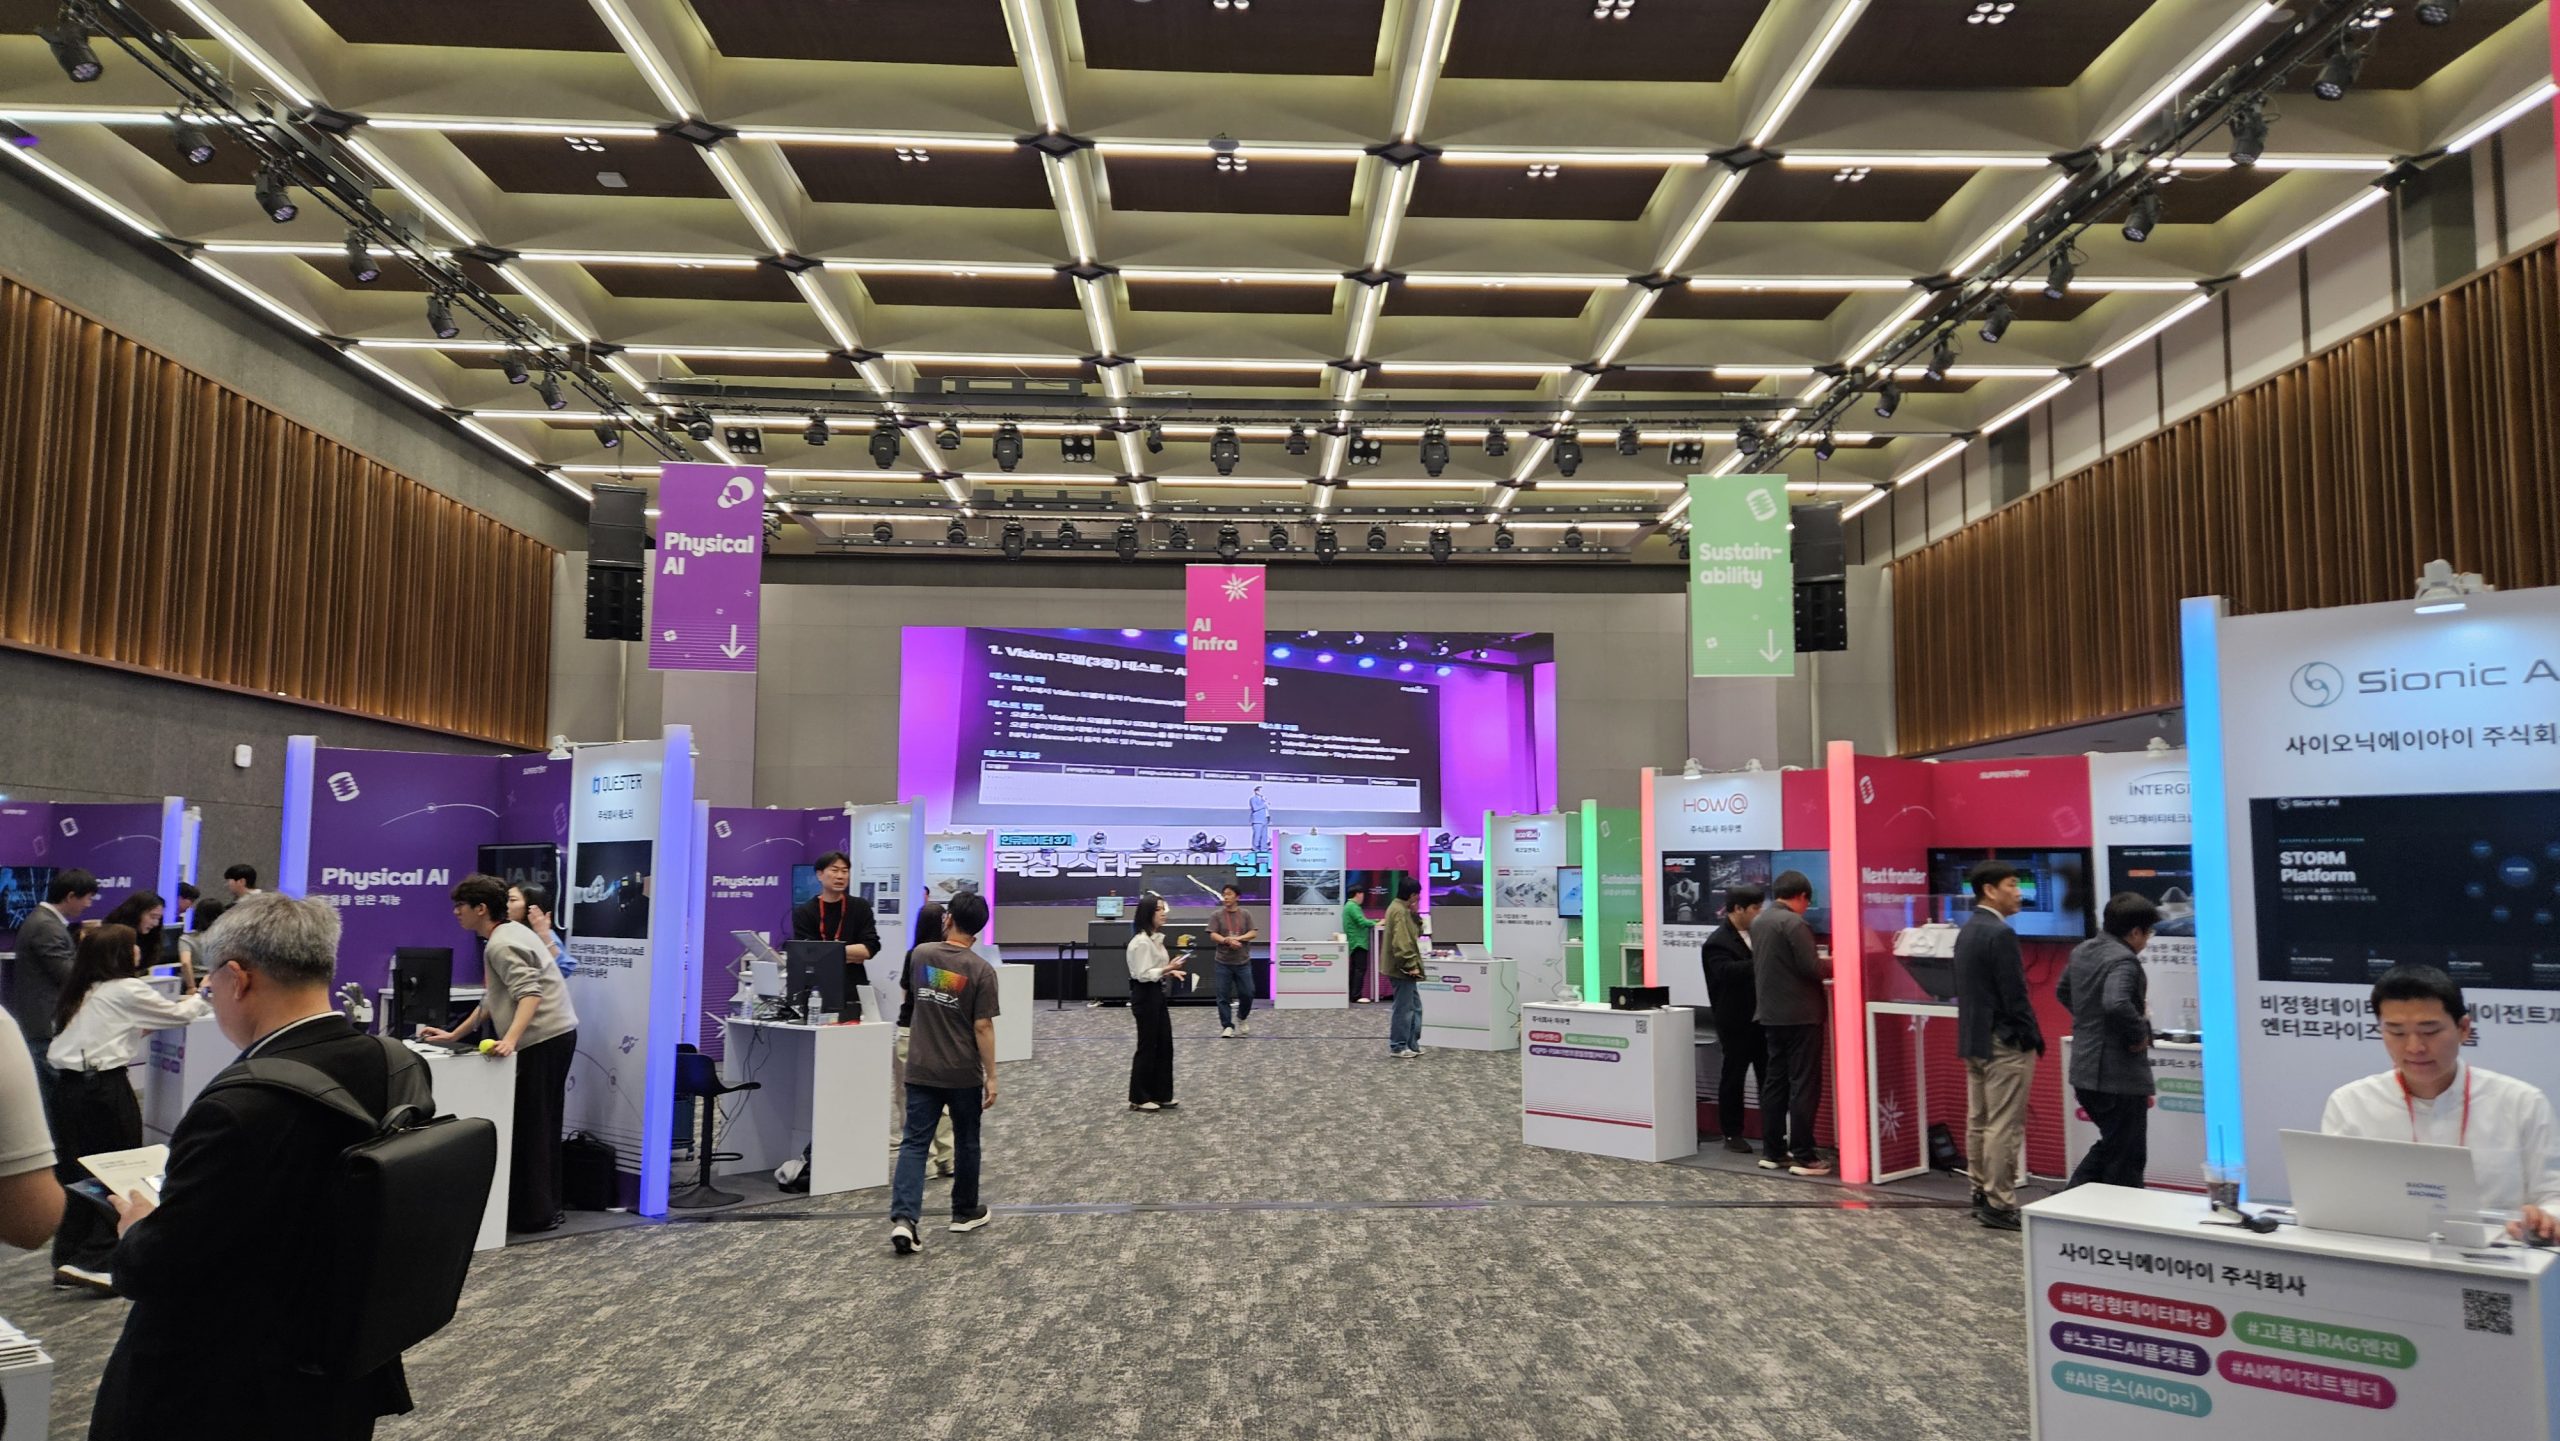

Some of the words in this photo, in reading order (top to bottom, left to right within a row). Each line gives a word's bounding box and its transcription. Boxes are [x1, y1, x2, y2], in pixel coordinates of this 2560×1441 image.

[664, 531, 755, 557] Physical
[1699, 542, 1783, 560] Sustain-
[662, 557, 685, 575] AI
[1700, 566, 1763, 589] ability
[1193, 618, 1211, 632] AI
[1193, 636, 1238, 651] Infra
[1005, 646, 1054, 662] Vision
[1055, 651, 1121, 671] 모델(3종)
[1122, 660, 1164, 674] 테스트
[2358, 662, 2507, 694] Sionic
[2285, 727, 2474, 756] 사이오닉에이아이
[2482, 722, 2560, 748] 주식회
[1683, 793, 1748, 814] HOW@
[2291, 798, 2325, 808] Sionic
[1000, 834, 1052, 846] 인큐베이터
[997, 852, 1060, 877] 육성
[2280, 851, 2346, 865] STORM
[321, 867, 423, 891] Physical
[426, 868, 449, 886] AI
[712, 875, 765, 889] Physical
[2281, 868, 2357, 882] Platform
[379, 895, 401, 906] 지능
[2058, 1241, 2214, 1283] 사이오닉에이아이
[2221, 1266, 2306, 1297] 주식회사
[2061, 1289, 2212, 1331] #비정형데이터파싱
[2063, 1329, 2197, 1369] #노코드AI플랫폼
[2247, 1319, 2401, 1361] #고품질RAG엔진
[2064, 1369, 2198, 1412] #AI옵스(AIOps)
[2231, 1358, 2381, 1402] #AI에이전트빌더
